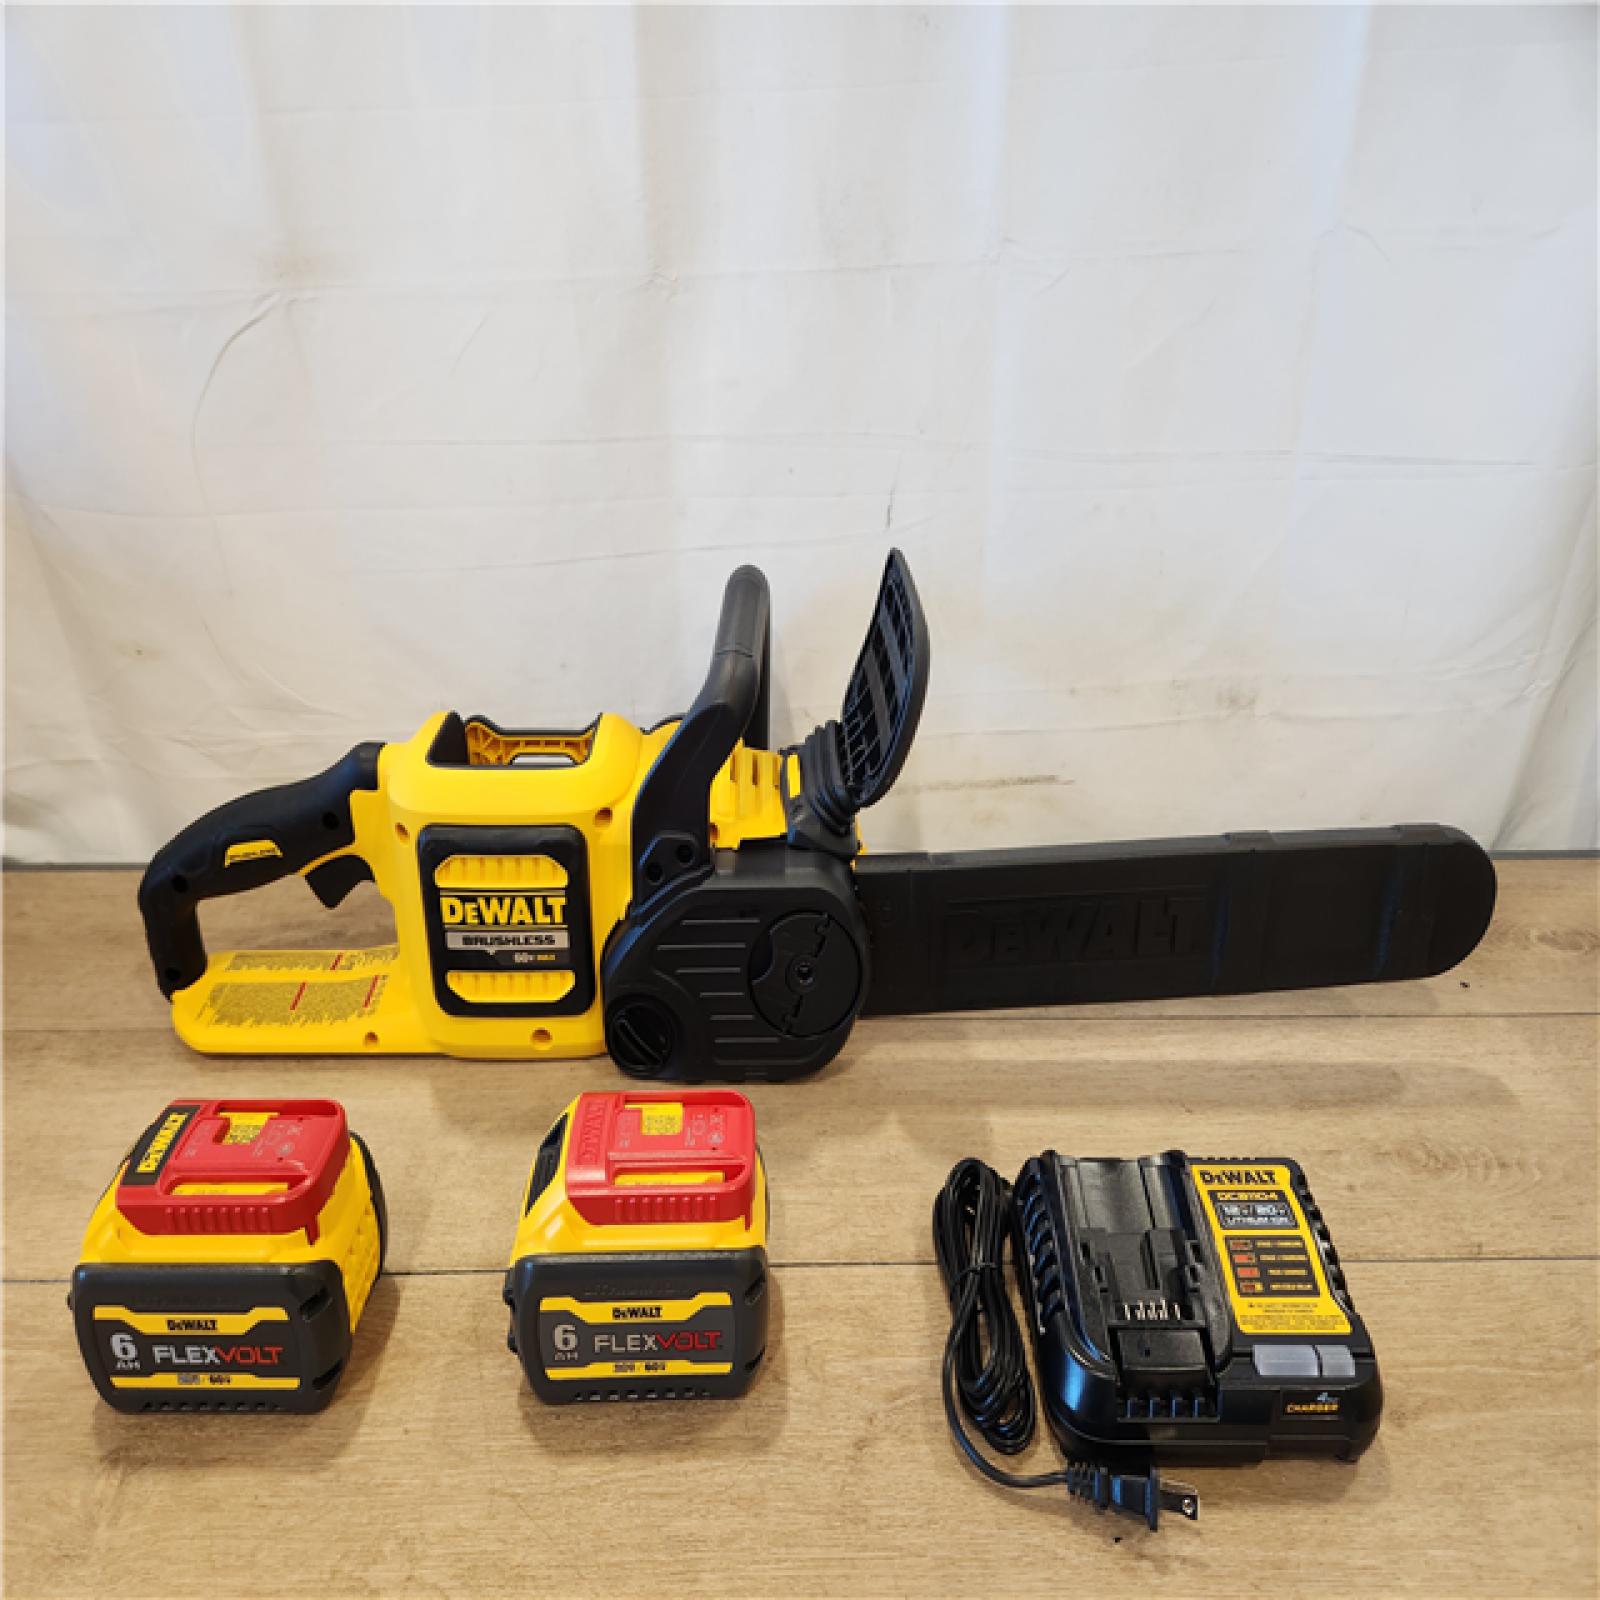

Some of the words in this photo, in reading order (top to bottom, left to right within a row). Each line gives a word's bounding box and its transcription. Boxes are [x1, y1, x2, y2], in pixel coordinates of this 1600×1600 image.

[440, 896, 567, 924] DEWALT
[462, 934, 556, 946] BRUSHLESS
[1200, 1170, 1276, 1185] DEWALT
[612, 1306, 663, 1319] DEWALT
[166, 1319, 218, 1331] DEWALT
[110, 1332, 138, 1359] 6
[554, 1324, 579, 1351] 6
[594, 1330, 722, 1354] FLEXVOLT
[151, 1345, 284, 1366] FLEXVOLT
[1286, 1403, 1339, 1413] CHARGER
